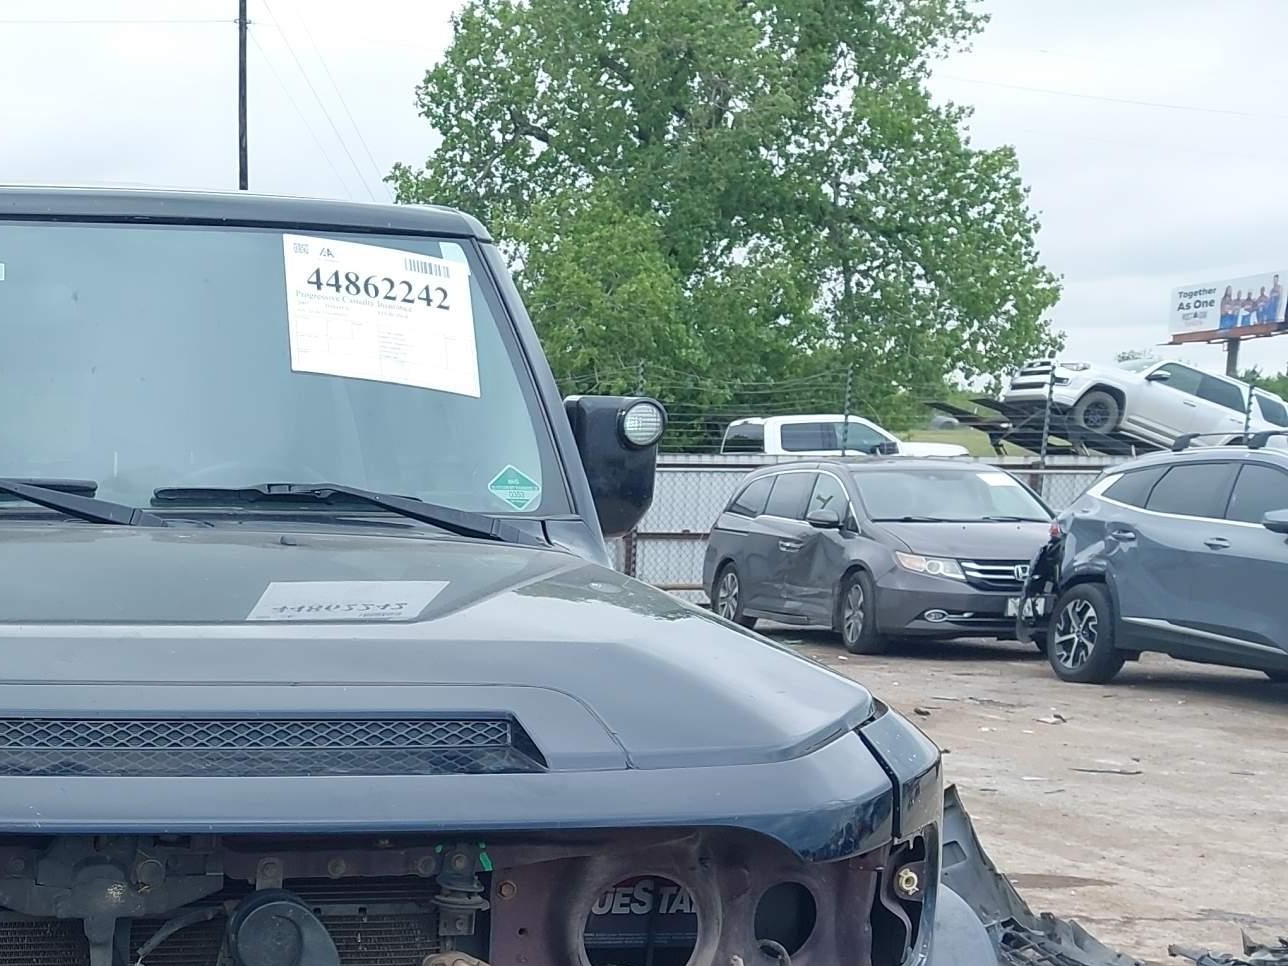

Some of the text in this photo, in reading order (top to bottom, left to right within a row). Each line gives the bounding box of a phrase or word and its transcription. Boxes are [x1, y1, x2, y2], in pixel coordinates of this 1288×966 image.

[306, 267, 451, 310] 44862242
[1178, 288, 1217, 299] Together
[1177, 299, 1215, 311] As One
